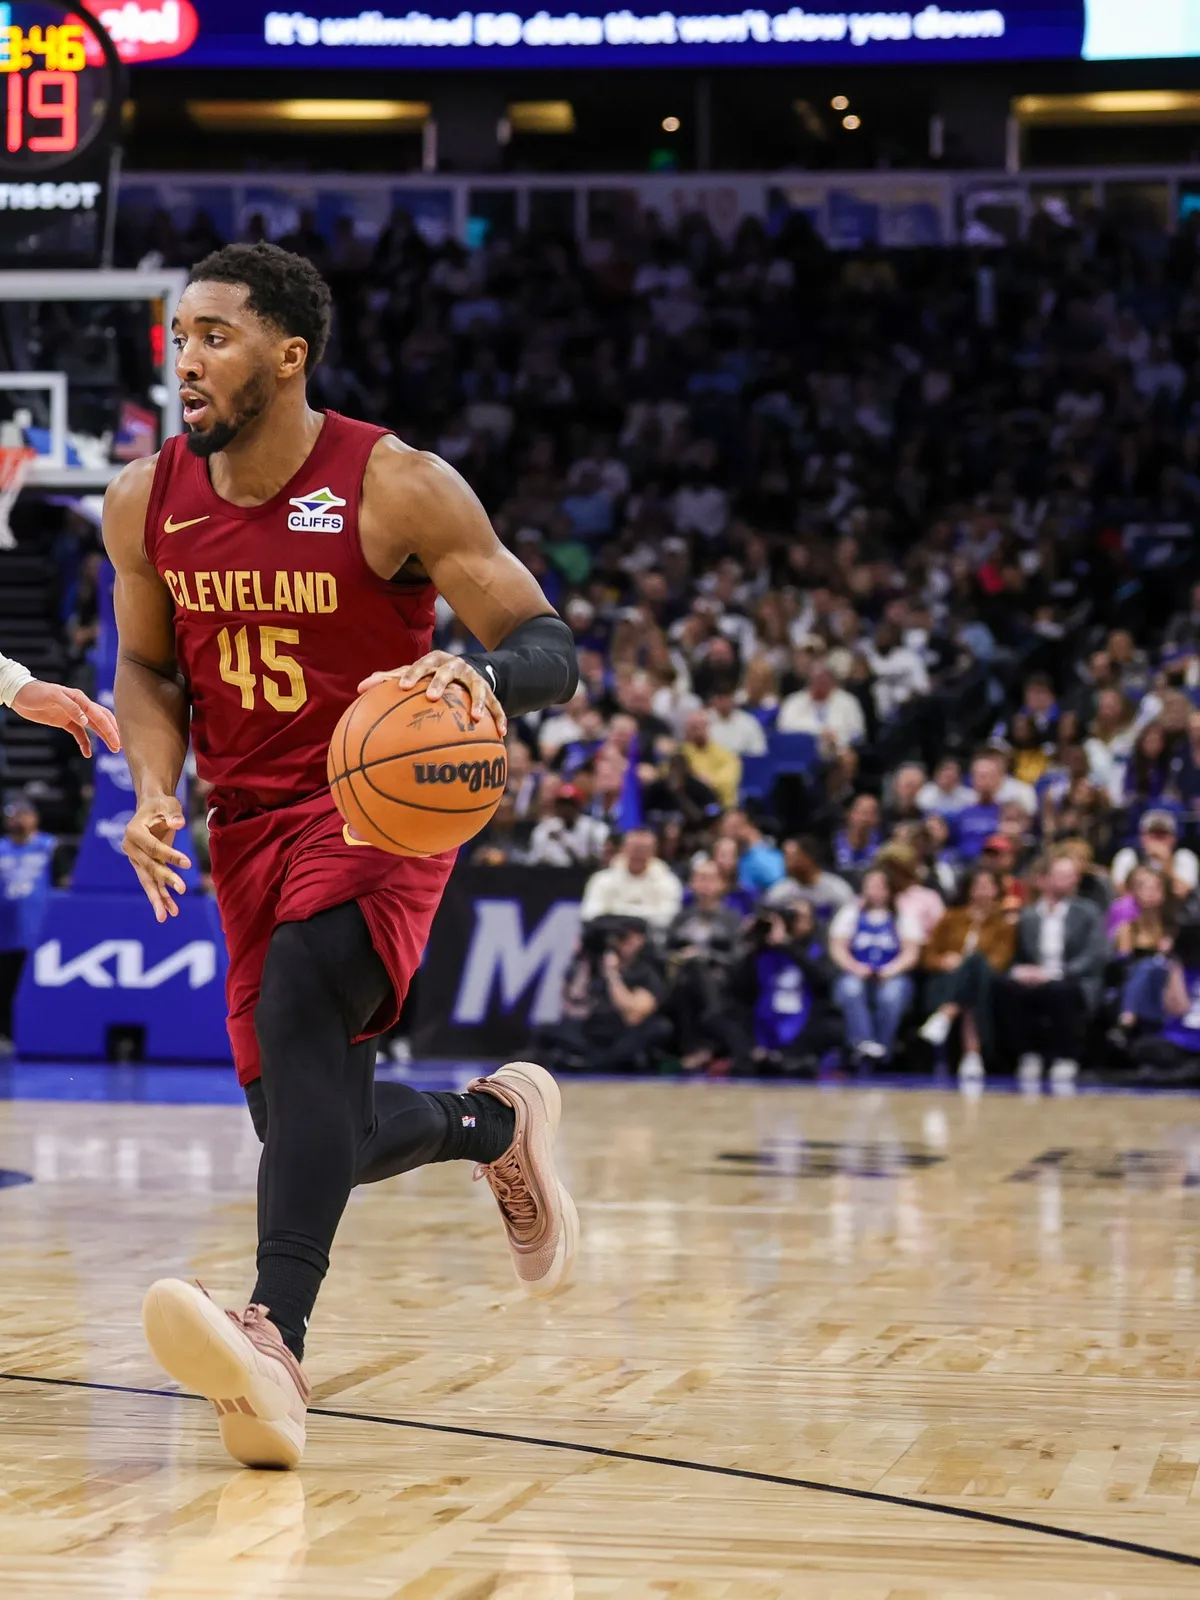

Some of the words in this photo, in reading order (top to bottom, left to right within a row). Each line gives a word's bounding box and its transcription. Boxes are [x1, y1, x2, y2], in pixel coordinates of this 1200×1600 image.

[264, 11, 319, 46] It's
[320, 11, 473, 47] unlimited
[522, 11, 603, 46] data
[603, 10, 677, 45] that
[677, 10, 771, 43] won't
[771, 7, 848, 42] slow
[848, 12, 912, 46] you
[912, 5, 1004, 40] down
[7, 70, 77, 152] 19
[290, 516, 342, 529] CLIFFS
[163, 569, 339, 615] CLEVELAND
[216, 625, 308, 712] 45
[413, 756, 506, 793] Wilson
